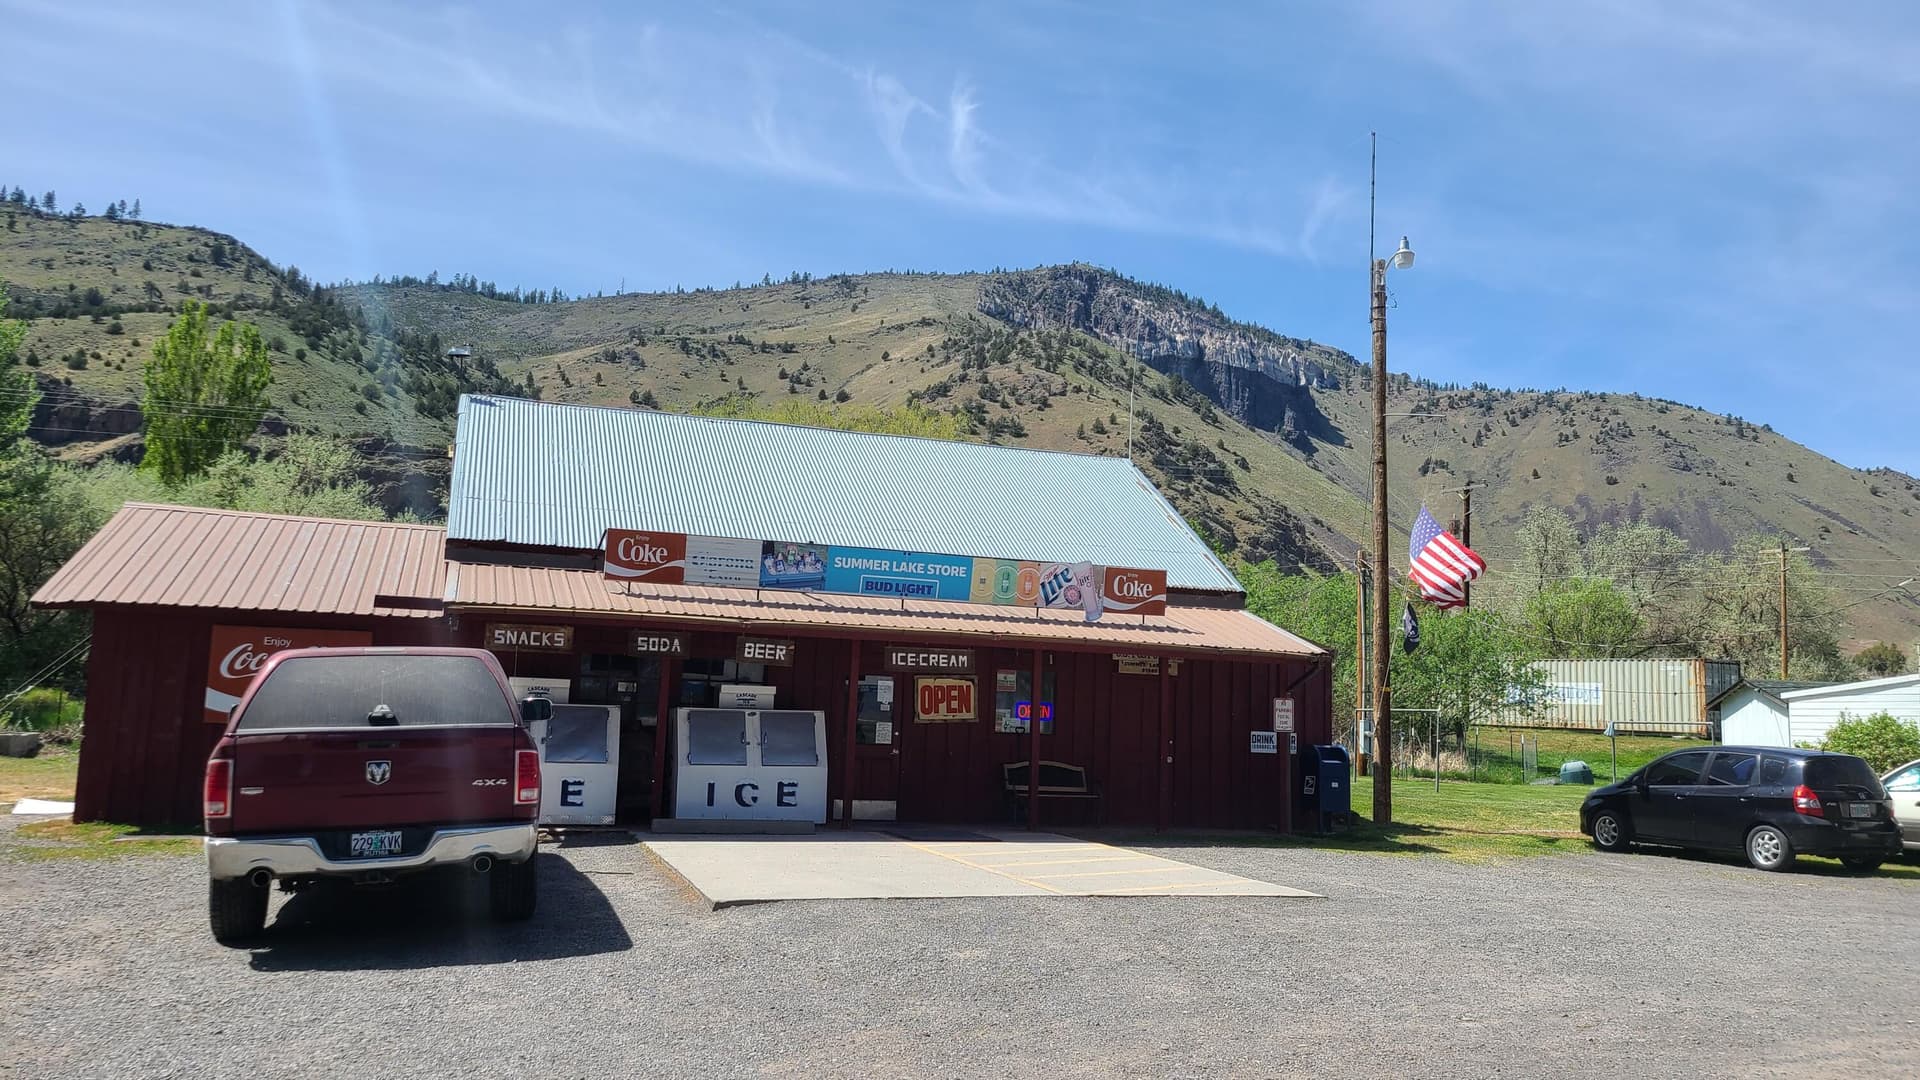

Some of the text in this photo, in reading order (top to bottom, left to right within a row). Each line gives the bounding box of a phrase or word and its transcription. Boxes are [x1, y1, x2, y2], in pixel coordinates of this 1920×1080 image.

[617, 537, 668, 564] Coke
[834, 556, 967, 577] SUMMER LAKE STORE
[865, 581, 933, 595] BUD LIGHT
[1113, 575, 1153, 598] Coke
[264, 636, 293, 648] Enjoy
[494, 629, 565, 647] SNACKS
[637, 636, 681, 652] SODA
[743, 642, 786, 661] BEER
[919, 684, 972, 716] OPEN
[1251, 734, 1275, 744] DRINK
[706, 781, 799, 807] ICE
[352, 834, 401, 851] 229 KVK
